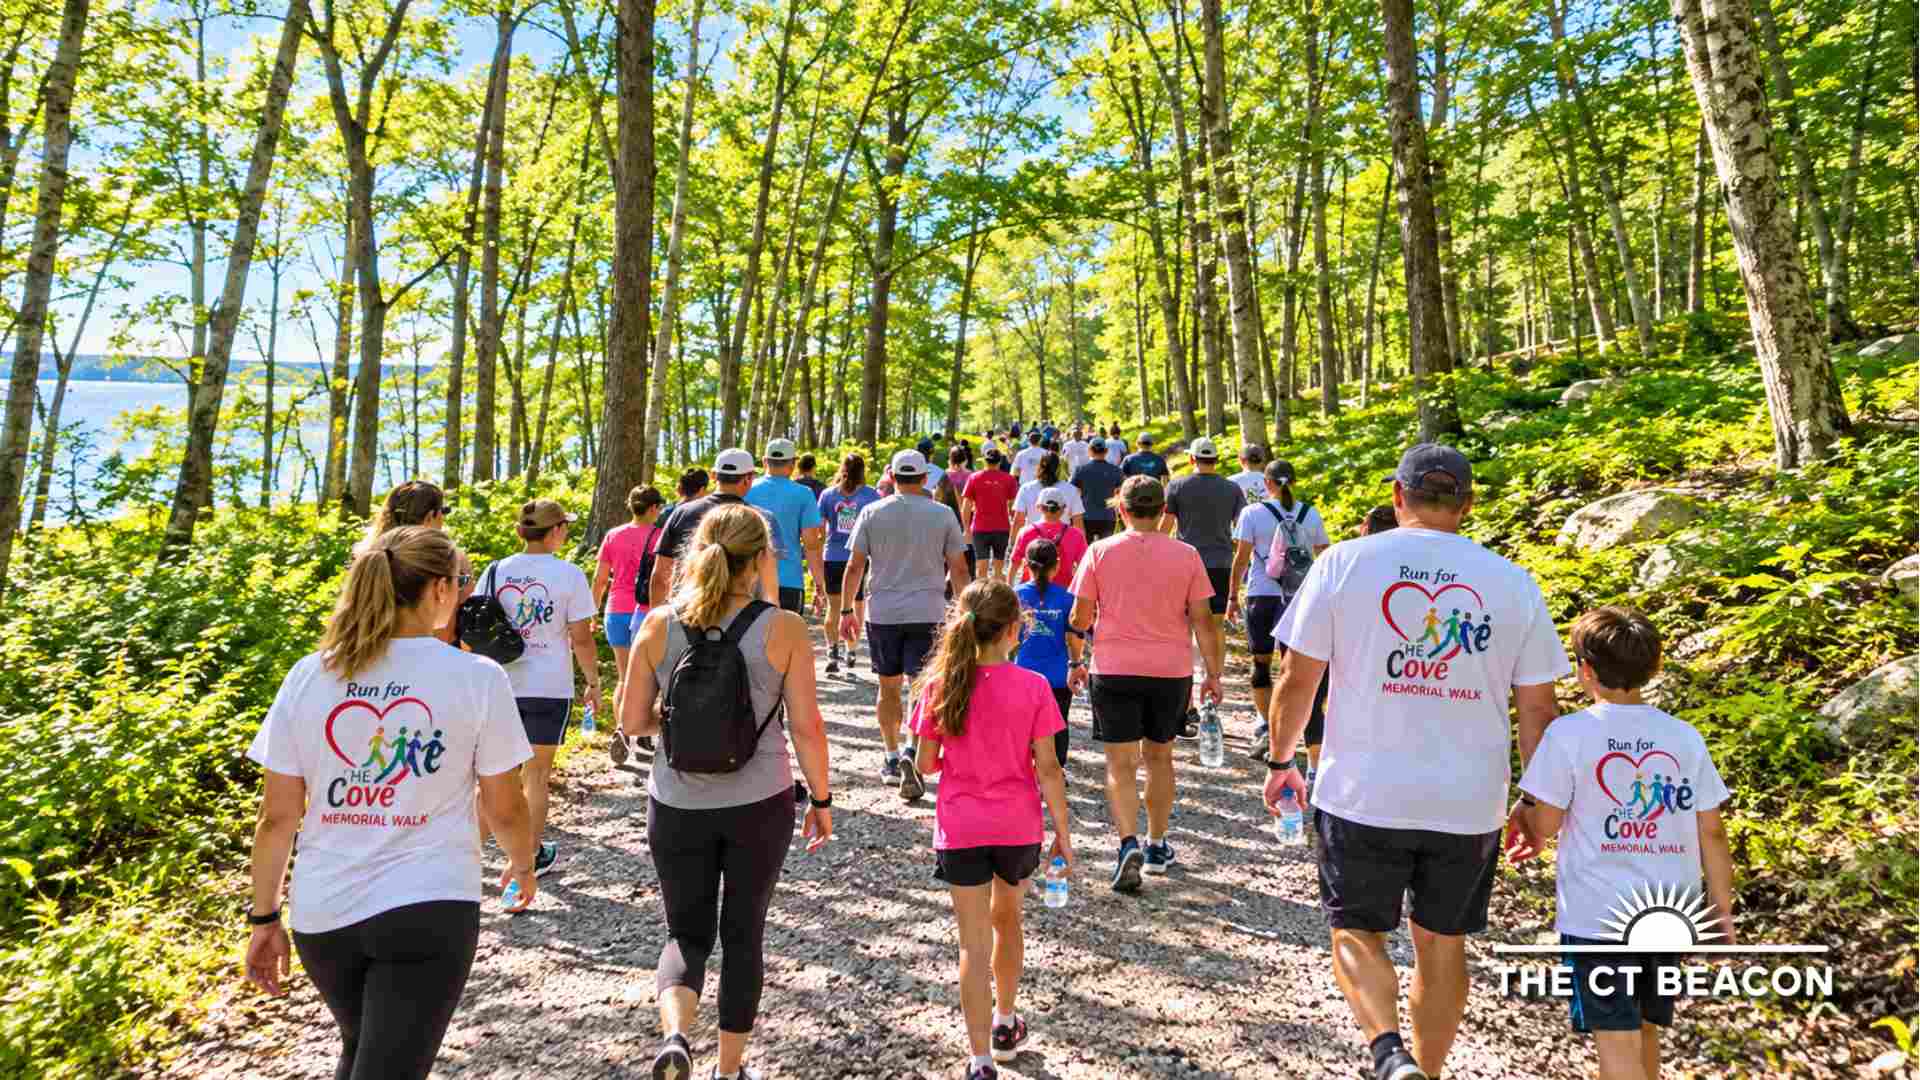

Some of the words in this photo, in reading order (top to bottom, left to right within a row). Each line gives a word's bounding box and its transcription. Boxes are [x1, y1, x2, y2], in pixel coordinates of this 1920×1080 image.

[1399, 565, 1429, 580] Run
[1433, 568, 1458, 584] for
[1386, 649, 1449, 680] Cove
[346, 682, 380, 698] Run
[383, 681, 411, 700] for
[1381, 682, 1444, 698] MEMORIAL
[1448, 687, 1483, 701] WALK
[1607, 738, 1632, 751] Run
[1636, 737, 1656, 753] for
[327, 776, 395, 808] Cove
[321, 812, 388, 827] MEMORIAL
[391, 813, 430, 827] WALK
[1604, 814, 1658, 840] Cove
[1600, 843, 1657, 854] MEMORIAL
[1658, 844, 1686, 854] WALK
